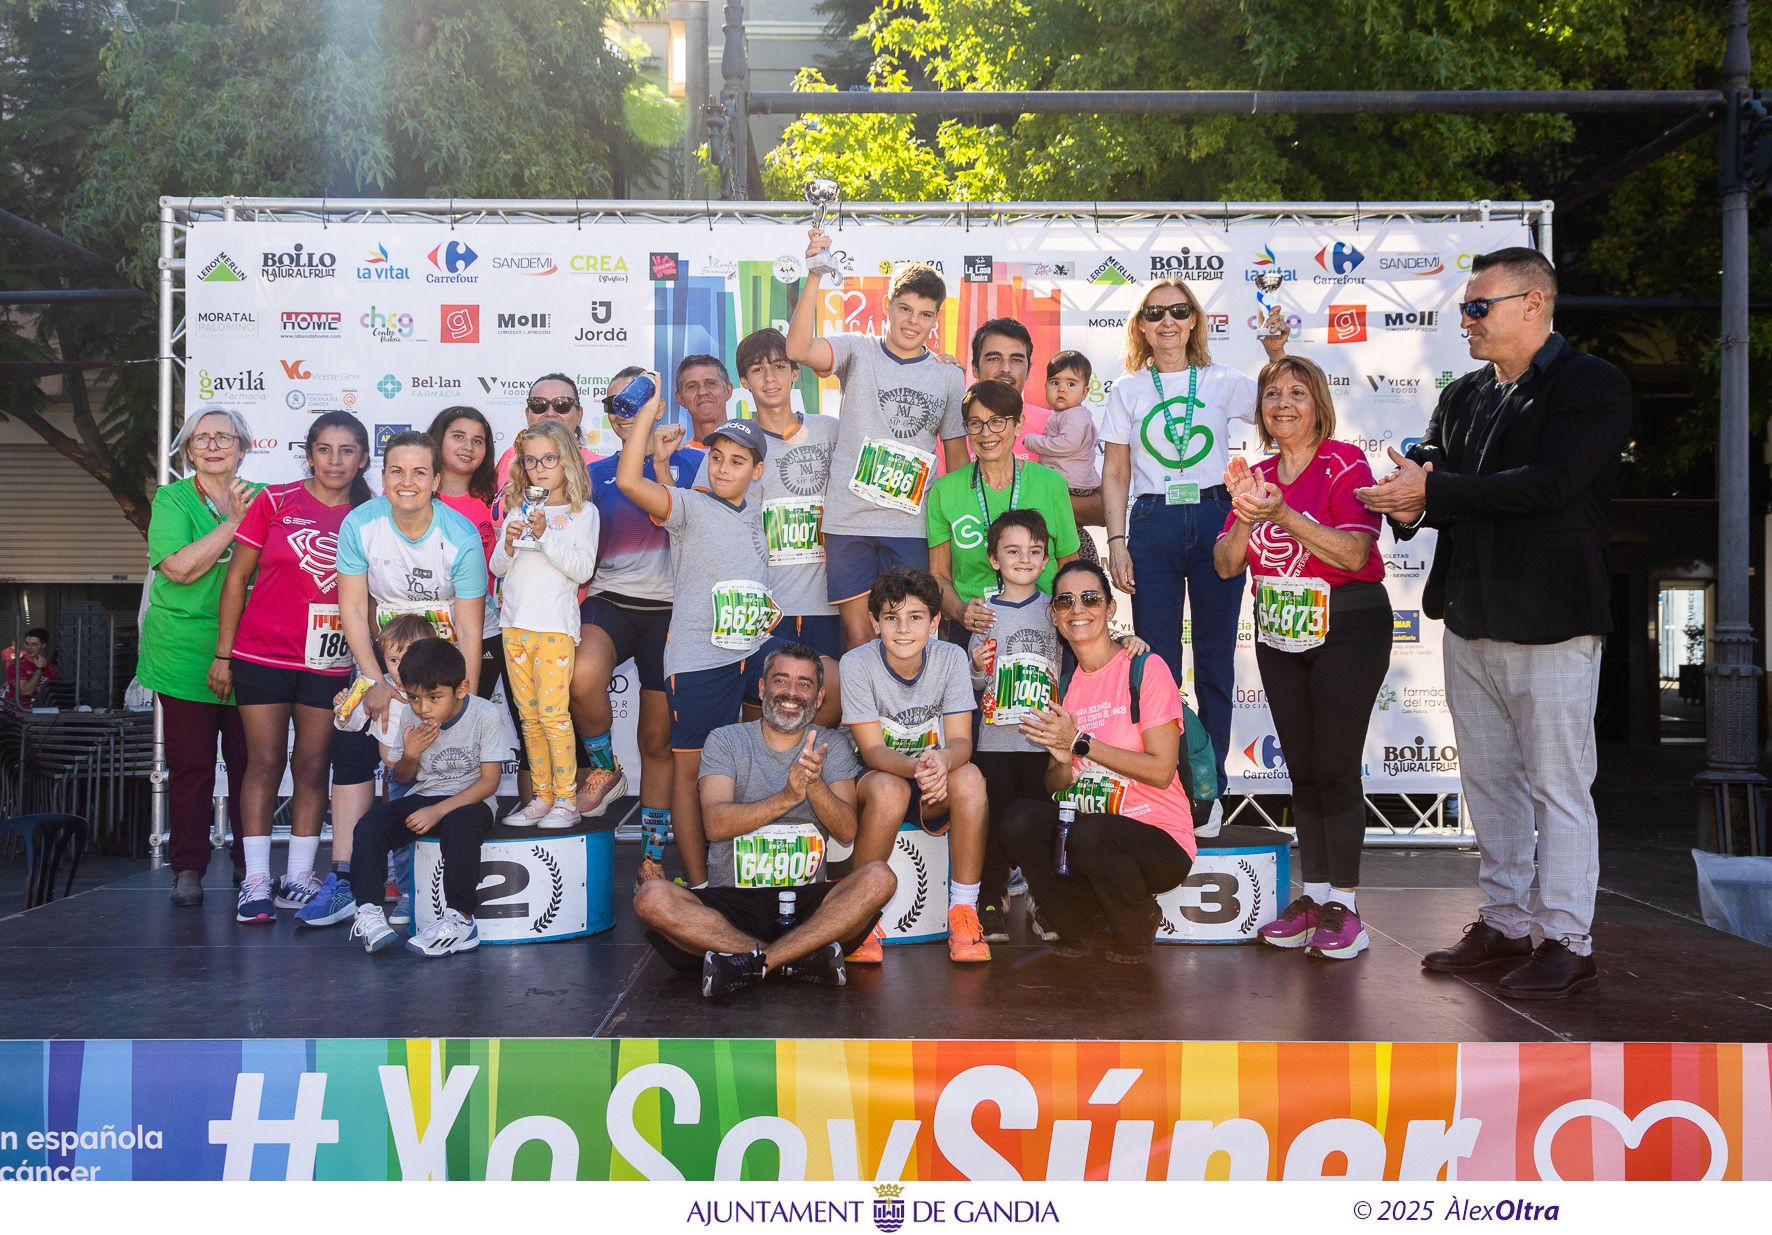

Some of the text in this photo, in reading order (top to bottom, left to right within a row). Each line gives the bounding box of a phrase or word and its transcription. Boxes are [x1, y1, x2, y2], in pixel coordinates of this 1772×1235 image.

[262, 247, 336, 267] BOLLO
[492, 257, 552, 269] SANDEMI
[570, 255, 629, 271] CREA
[1150, 251, 1224, 270] BOLLO
[1379, 256, 1440, 270] SANDEMI
[197, 251, 247, 281] LEROY MERLIN
[357, 265, 410, 279] la vital
[1086, 262, 1109, 284] LEROY
[1106, 255, 1137, 285] MERLIN
[262, 268, 336, 282] NATURALFRUIT
[426, 274, 479, 284] Carrefour
[1313, 275, 1366, 285] Carrefour
[198, 313, 256, 322] MORATAL
[281, 313, 341, 330] HOME
[497, 313, 547, 328] Moll
[1089, 319, 1125, 328] MORA
[1384, 311, 1434, 327] Moll
[199, 369, 265, 400] gavilá
[500, 381, 532, 389] VICKY
[576, 374, 610, 385] farma
[714, 422, 751, 434] adidas
[875, 464, 914, 493] 1286
[781, 522, 817, 543] 1007
[1385, 561, 1425, 571] ALI
[1258, 603, 1326, 632] 64873
[1013, 679, 1051, 705] 1005
[1403, 687, 1445, 697] farmàc
[1403, 697, 1447, 707] del rava
[1383, 740, 1458, 761] BOLLO
[1243, 769, 1290, 780] Carrefou
[1383, 762, 1458, 776] NATURALFRUIT
[740, 851, 821, 880] 64906
[474, 861, 530, 919] 2
[1180, 873, 1241, 924] 3
[26, 1124, 163, 1156] española
[0, 1160, 101, 1181] cáncer
